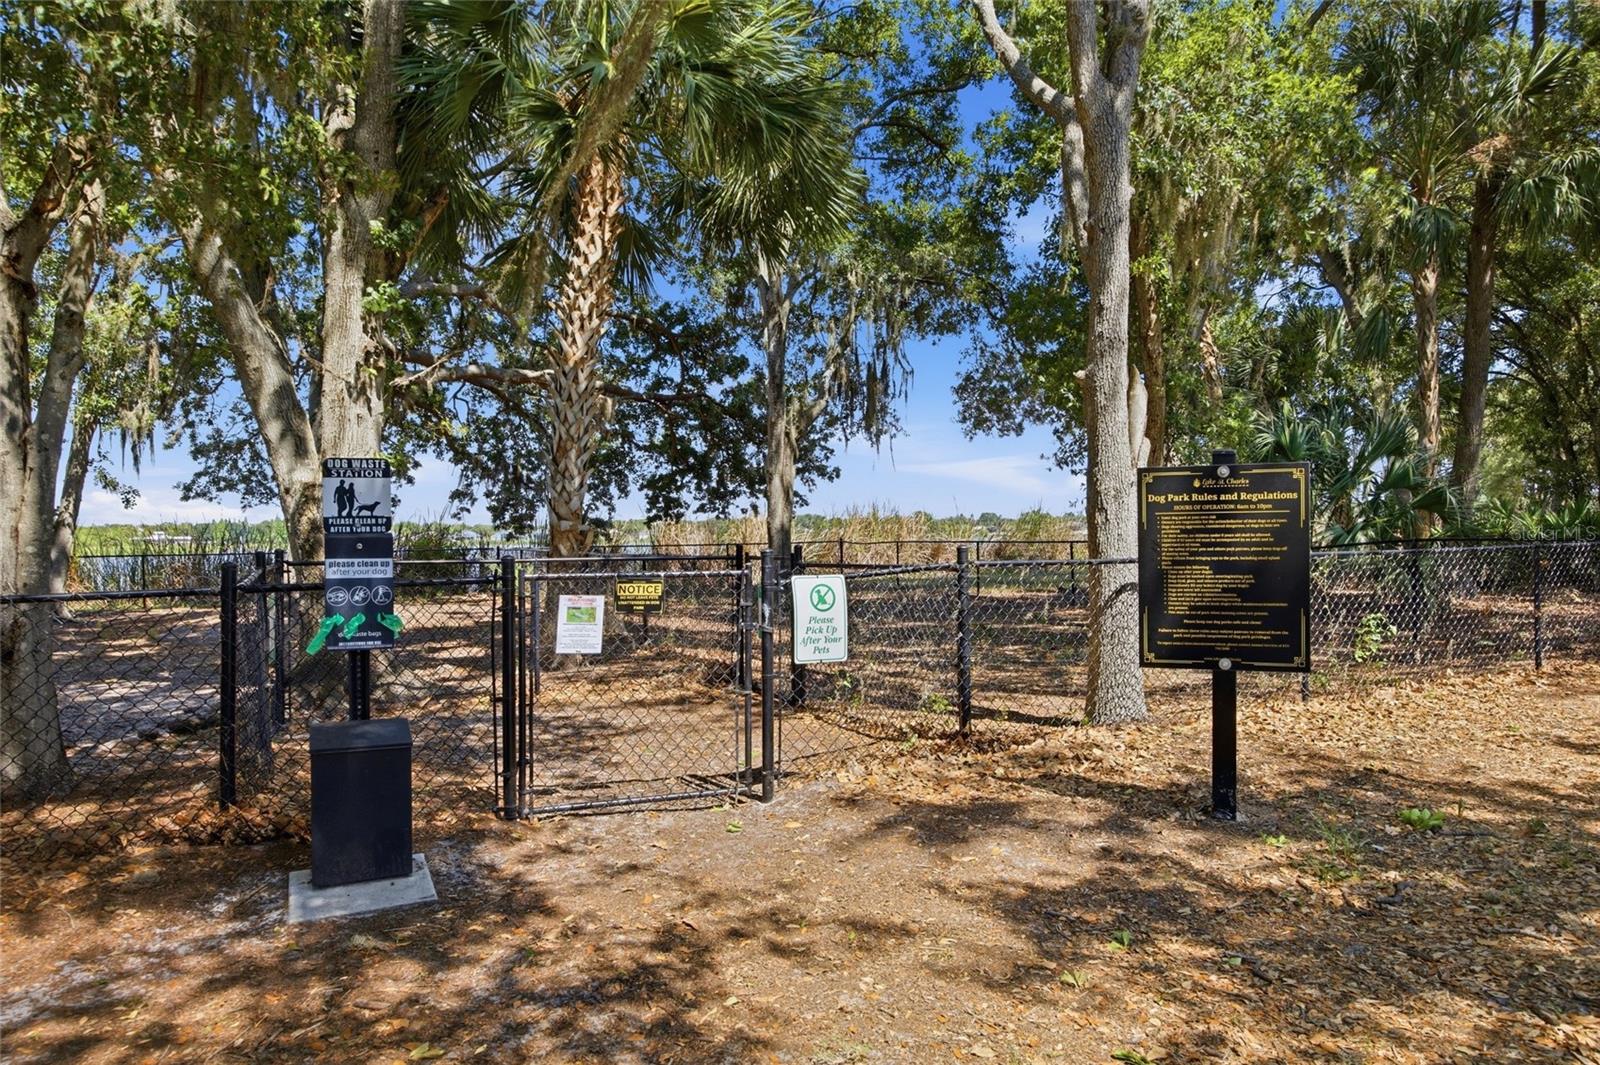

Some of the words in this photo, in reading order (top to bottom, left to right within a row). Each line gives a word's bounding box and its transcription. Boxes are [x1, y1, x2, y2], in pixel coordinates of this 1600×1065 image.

[327, 459, 348, 468] DOG
[352, 459, 386, 468] WASTE
[331, 469, 383, 477] STATION
[1148, 494, 1166, 504] Dog
[1167, 493, 1190, 502] Park
[1191, 492, 1218, 502] Rules
[1219, 492, 1238, 500] and
[1240, 490, 1298, 502] Regulations
[352, 568, 370, 576] your
[618, 585, 660, 594] NOTICE
[808, 616, 835, 625] Please
[805, 626, 824, 635] Pick
[826, 625, 838, 636] Up
[800, 636, 822, 648] After
[824, 635, 843, 643] Your
[812, 646, 830, 655] Pets
